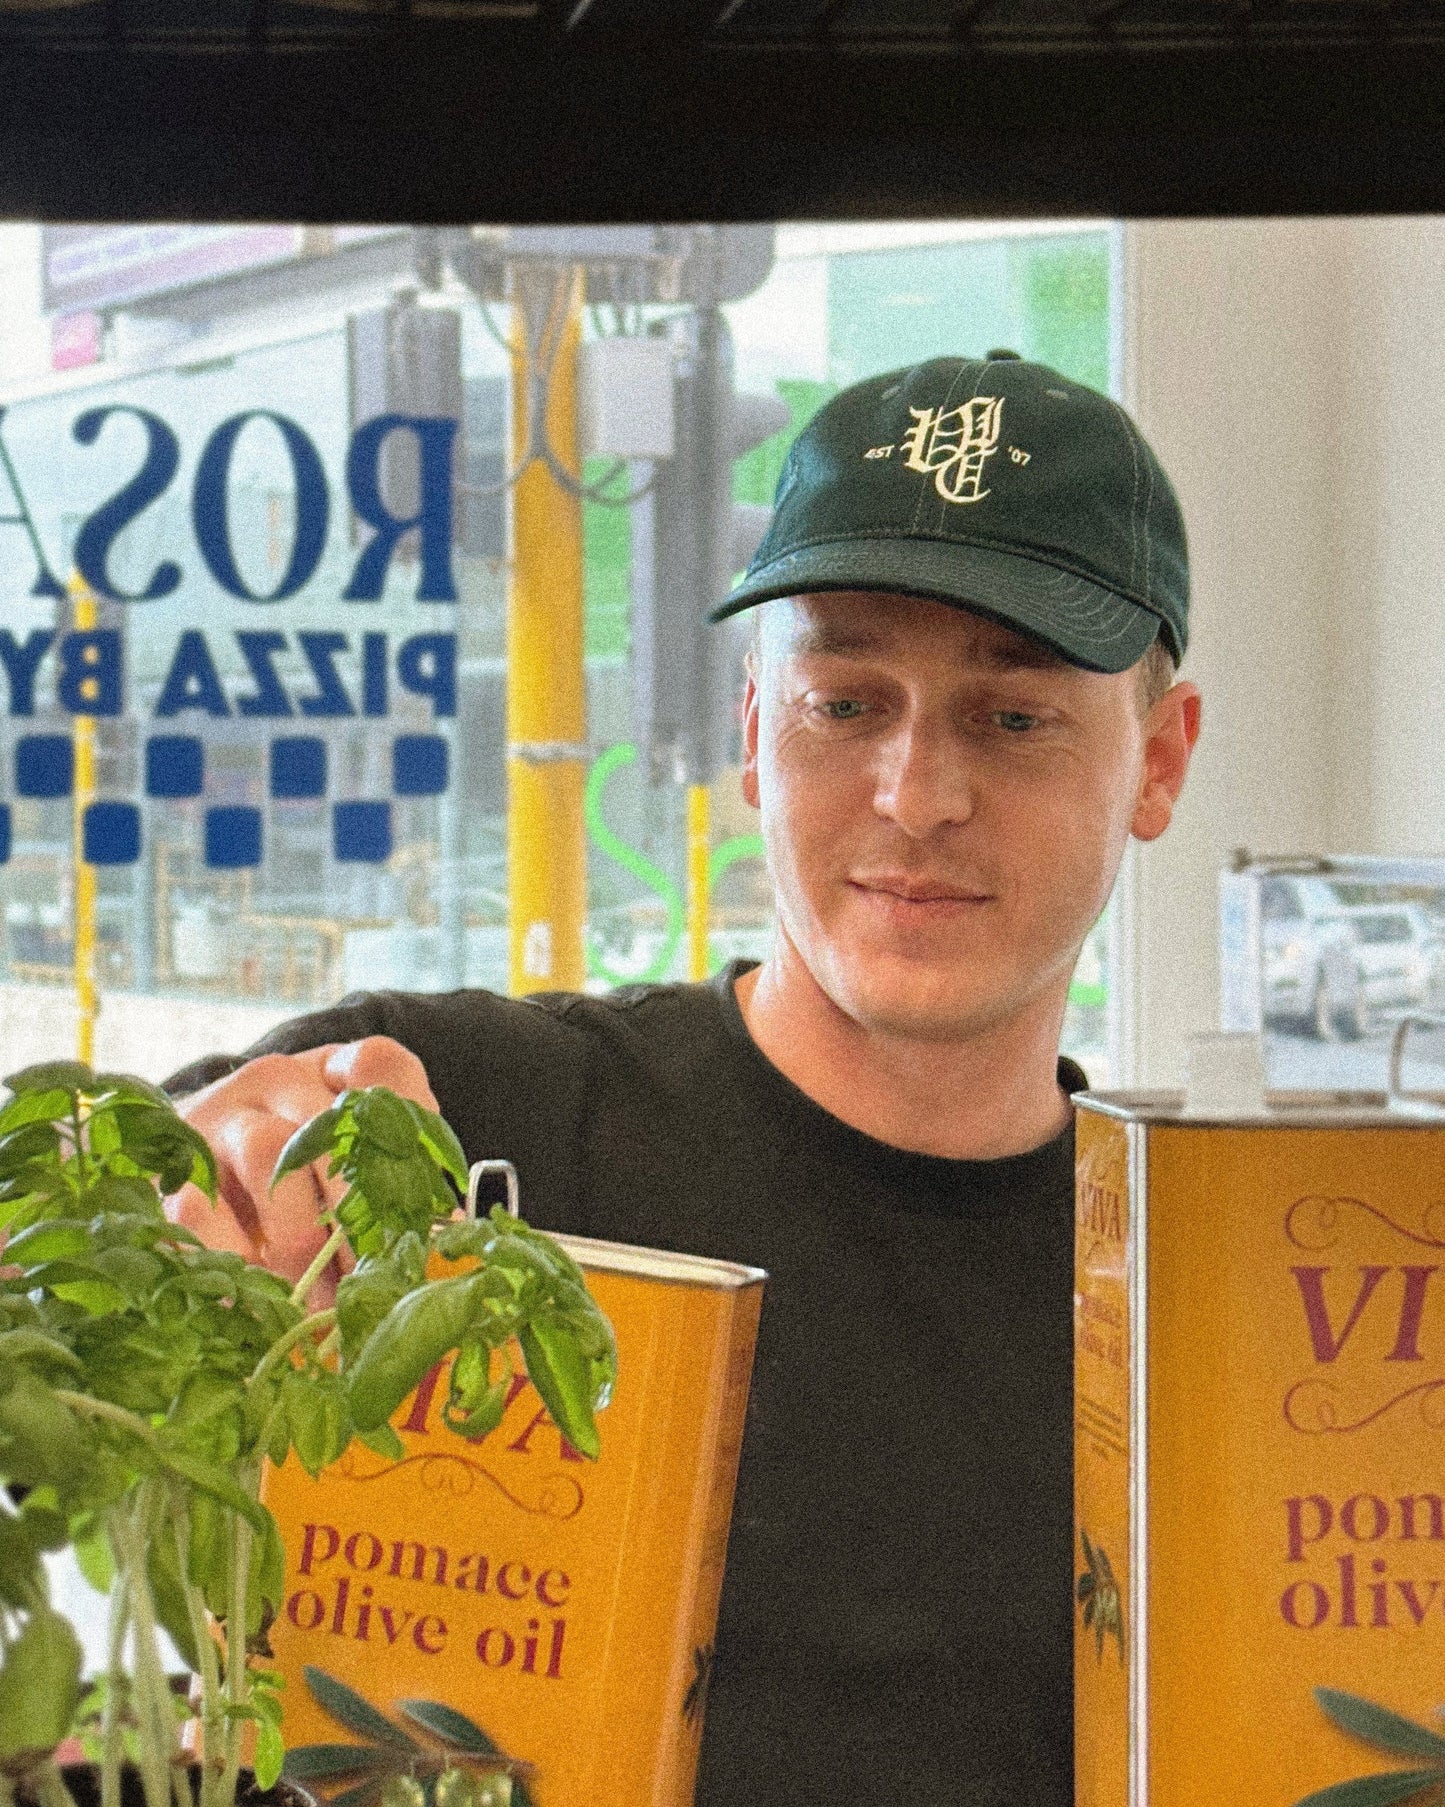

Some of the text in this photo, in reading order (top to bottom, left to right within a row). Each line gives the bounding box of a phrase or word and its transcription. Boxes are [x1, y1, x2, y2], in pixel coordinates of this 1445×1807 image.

[863, 444, 896, 460] EST
[295, 1522, 572, 1609] pomace
[286, 1577, 568, 1681] olive oil
